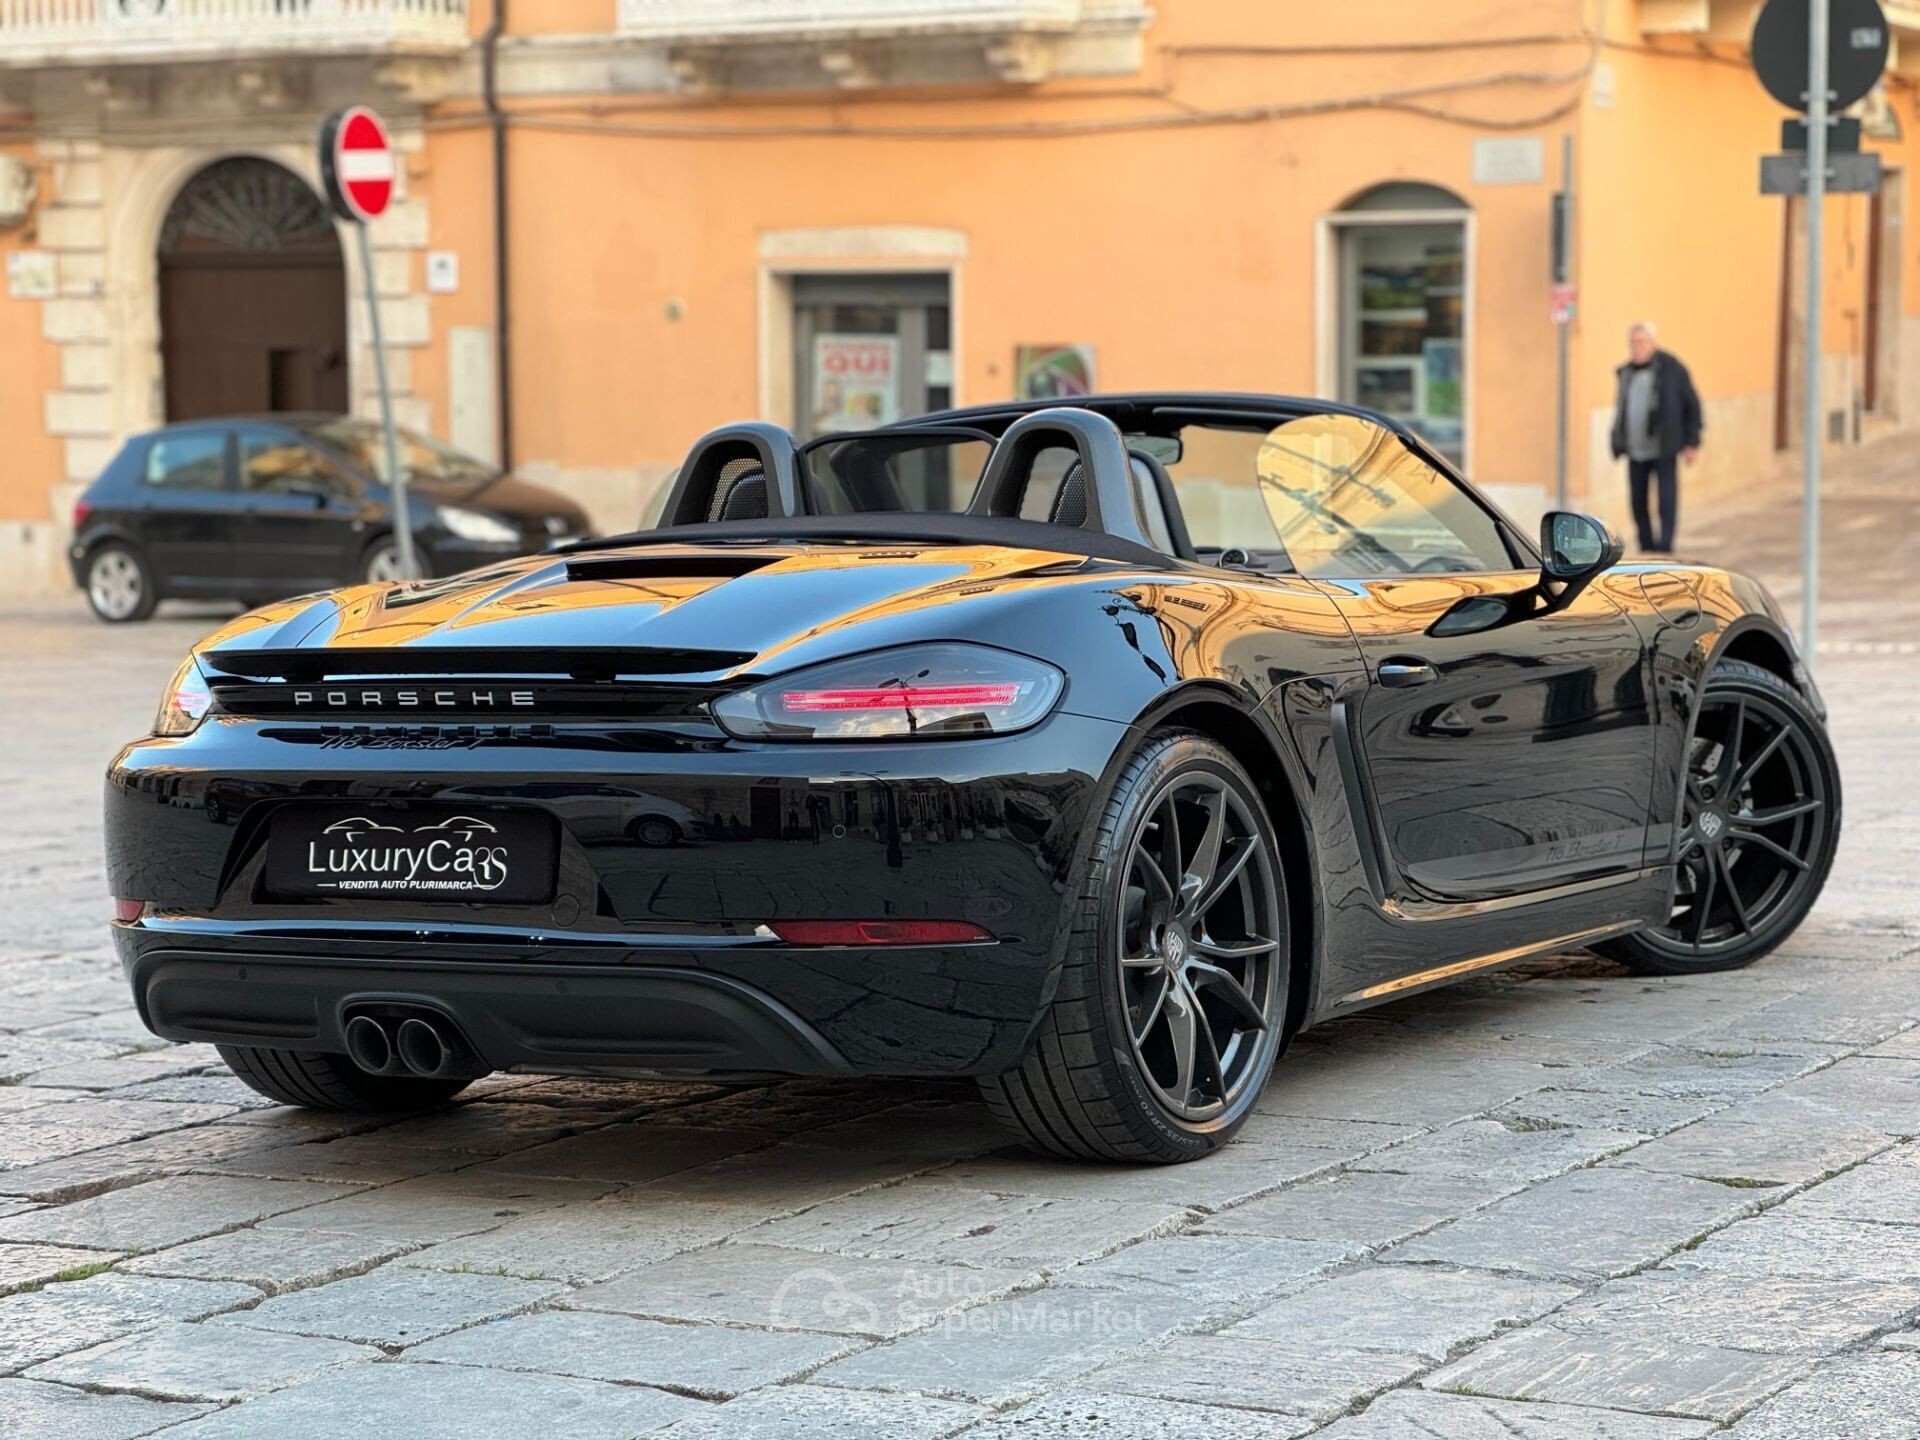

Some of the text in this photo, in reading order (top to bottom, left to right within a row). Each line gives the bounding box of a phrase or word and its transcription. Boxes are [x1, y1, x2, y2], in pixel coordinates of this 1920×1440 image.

[823, 351, 891, 375] QUI
[294, 691, 535, 706] PORSCHE
[319, 734, 488, 750] 718 Boxster T
[338, 880, 474, 890] VENDITA AUTO PLURIMARCA
